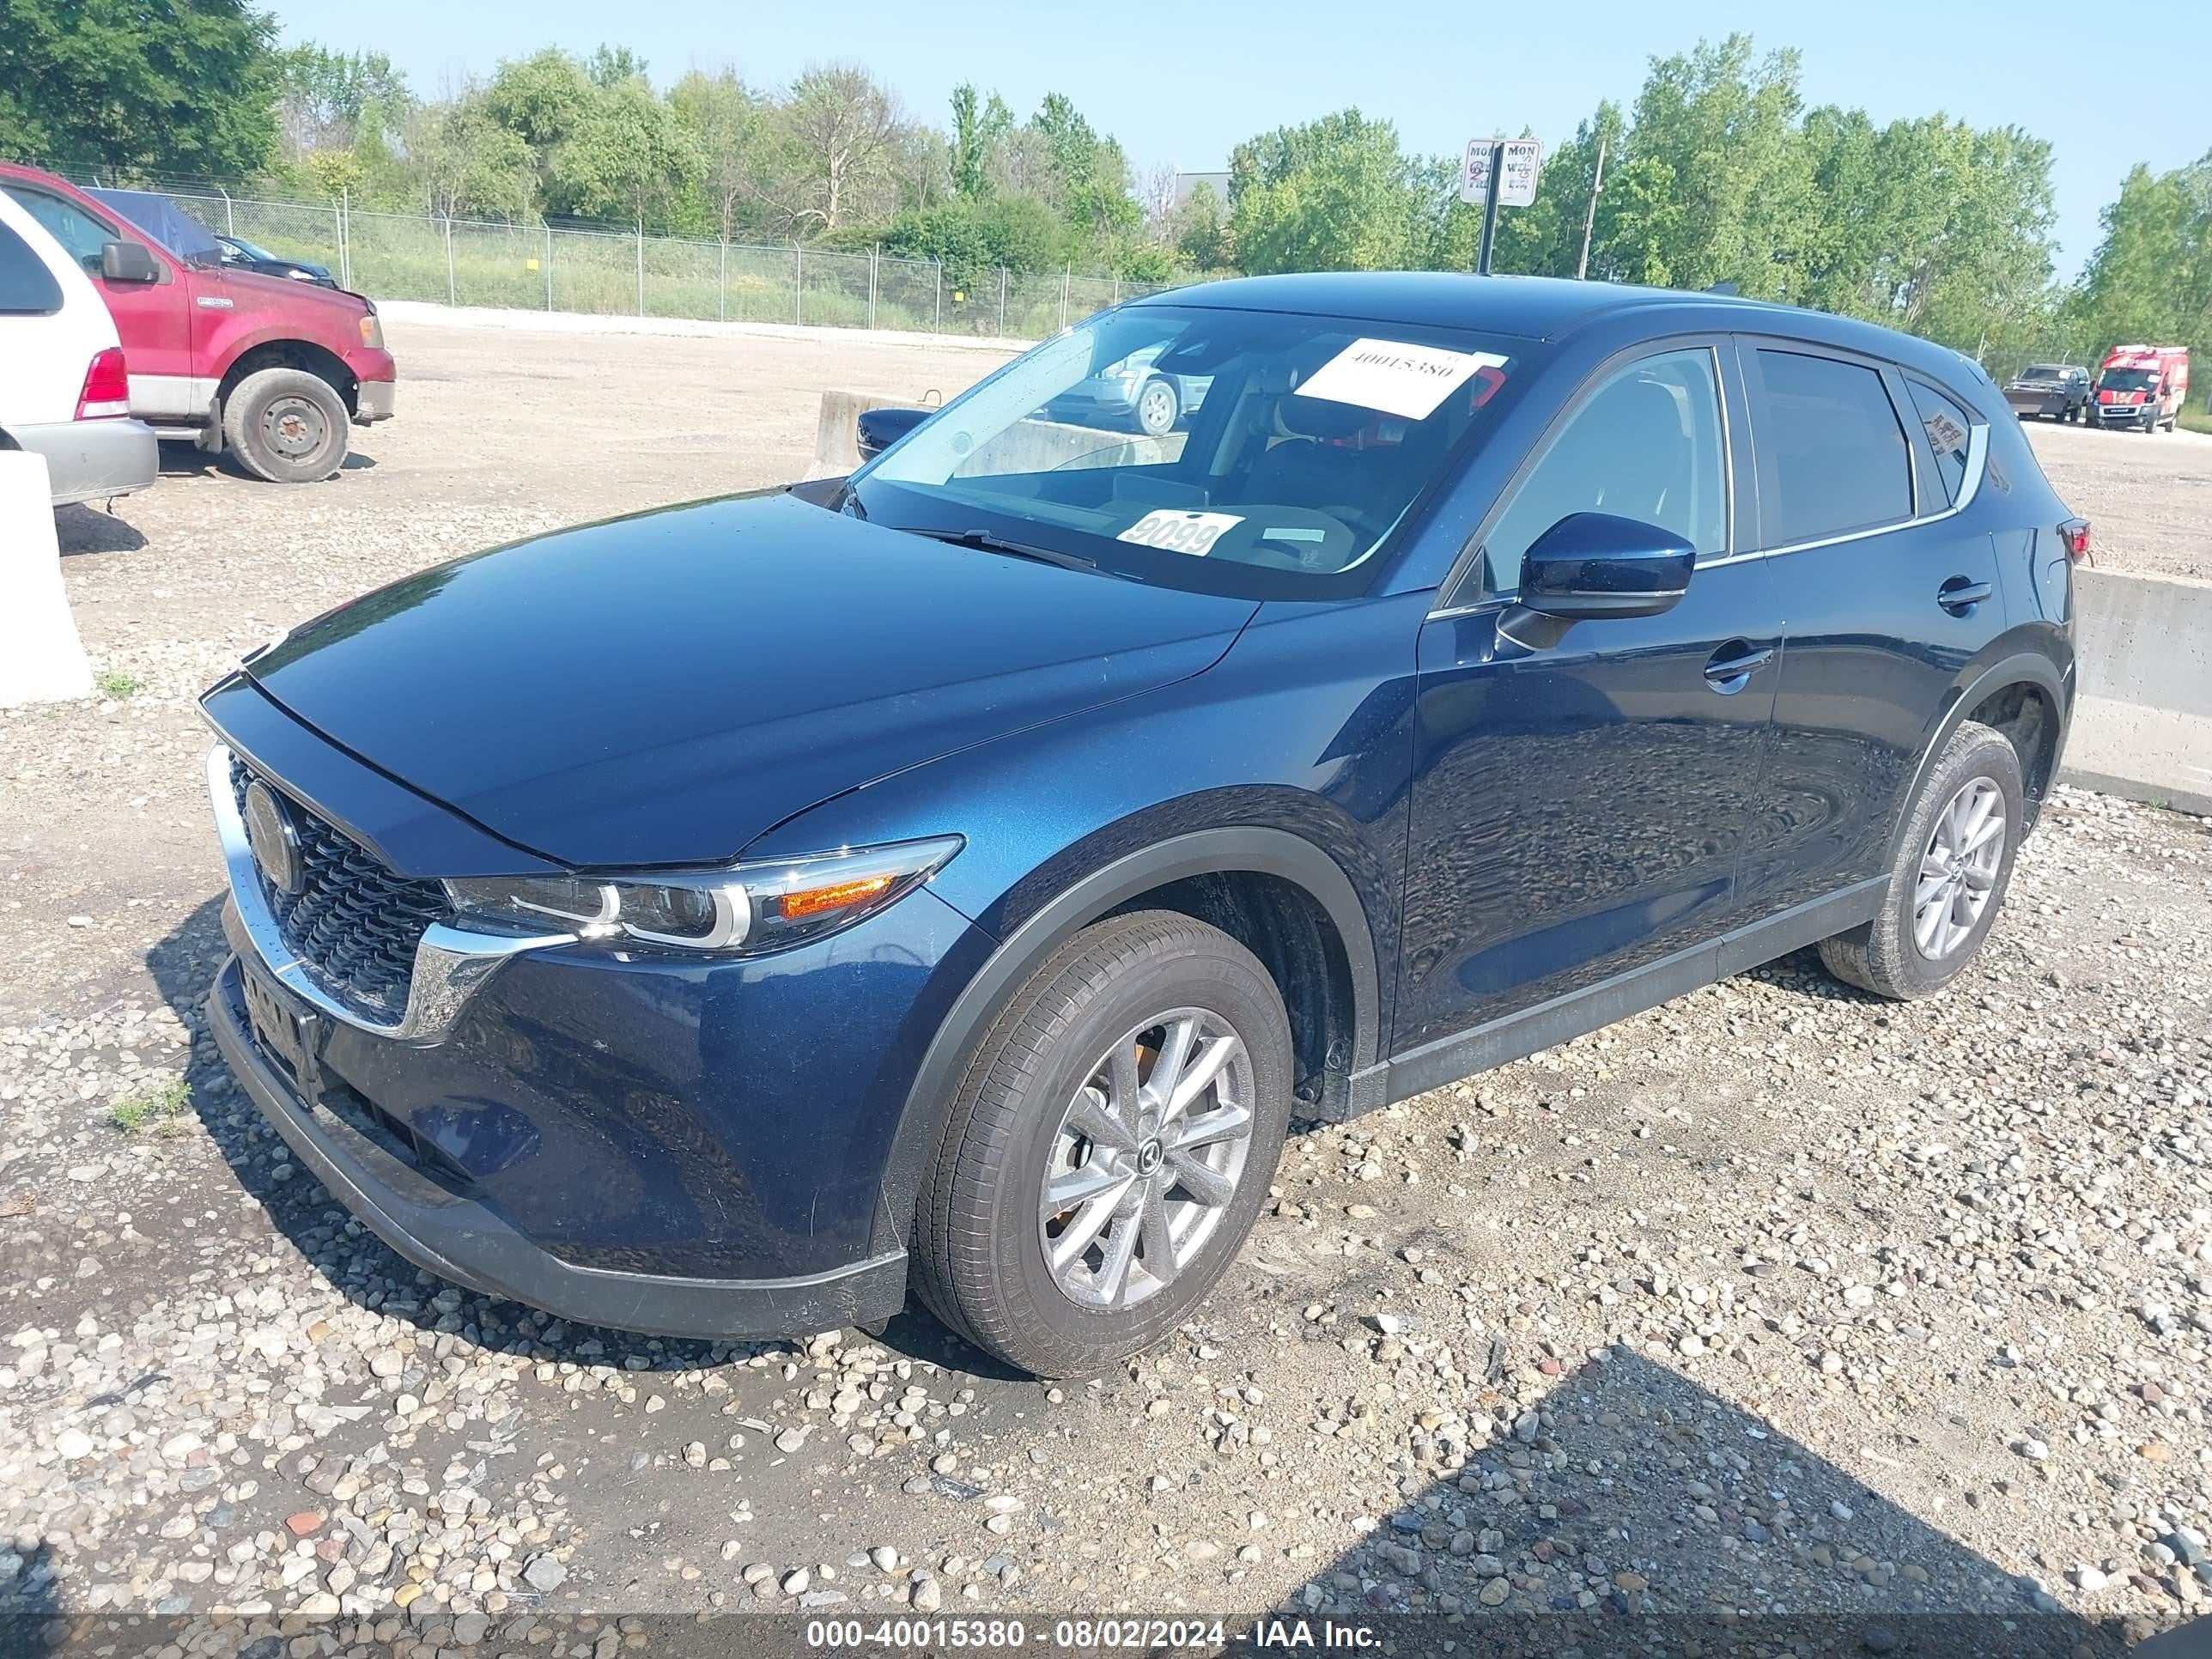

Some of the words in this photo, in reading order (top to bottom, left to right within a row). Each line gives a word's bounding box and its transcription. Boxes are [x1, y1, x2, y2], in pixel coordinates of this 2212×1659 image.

[1470, 147, 1492, 156] MO
[1508, 145, 1535, 156] MON
[1351, 352, 1454, 378] 40015380
[1126, 517, 1219, 552] 9099
